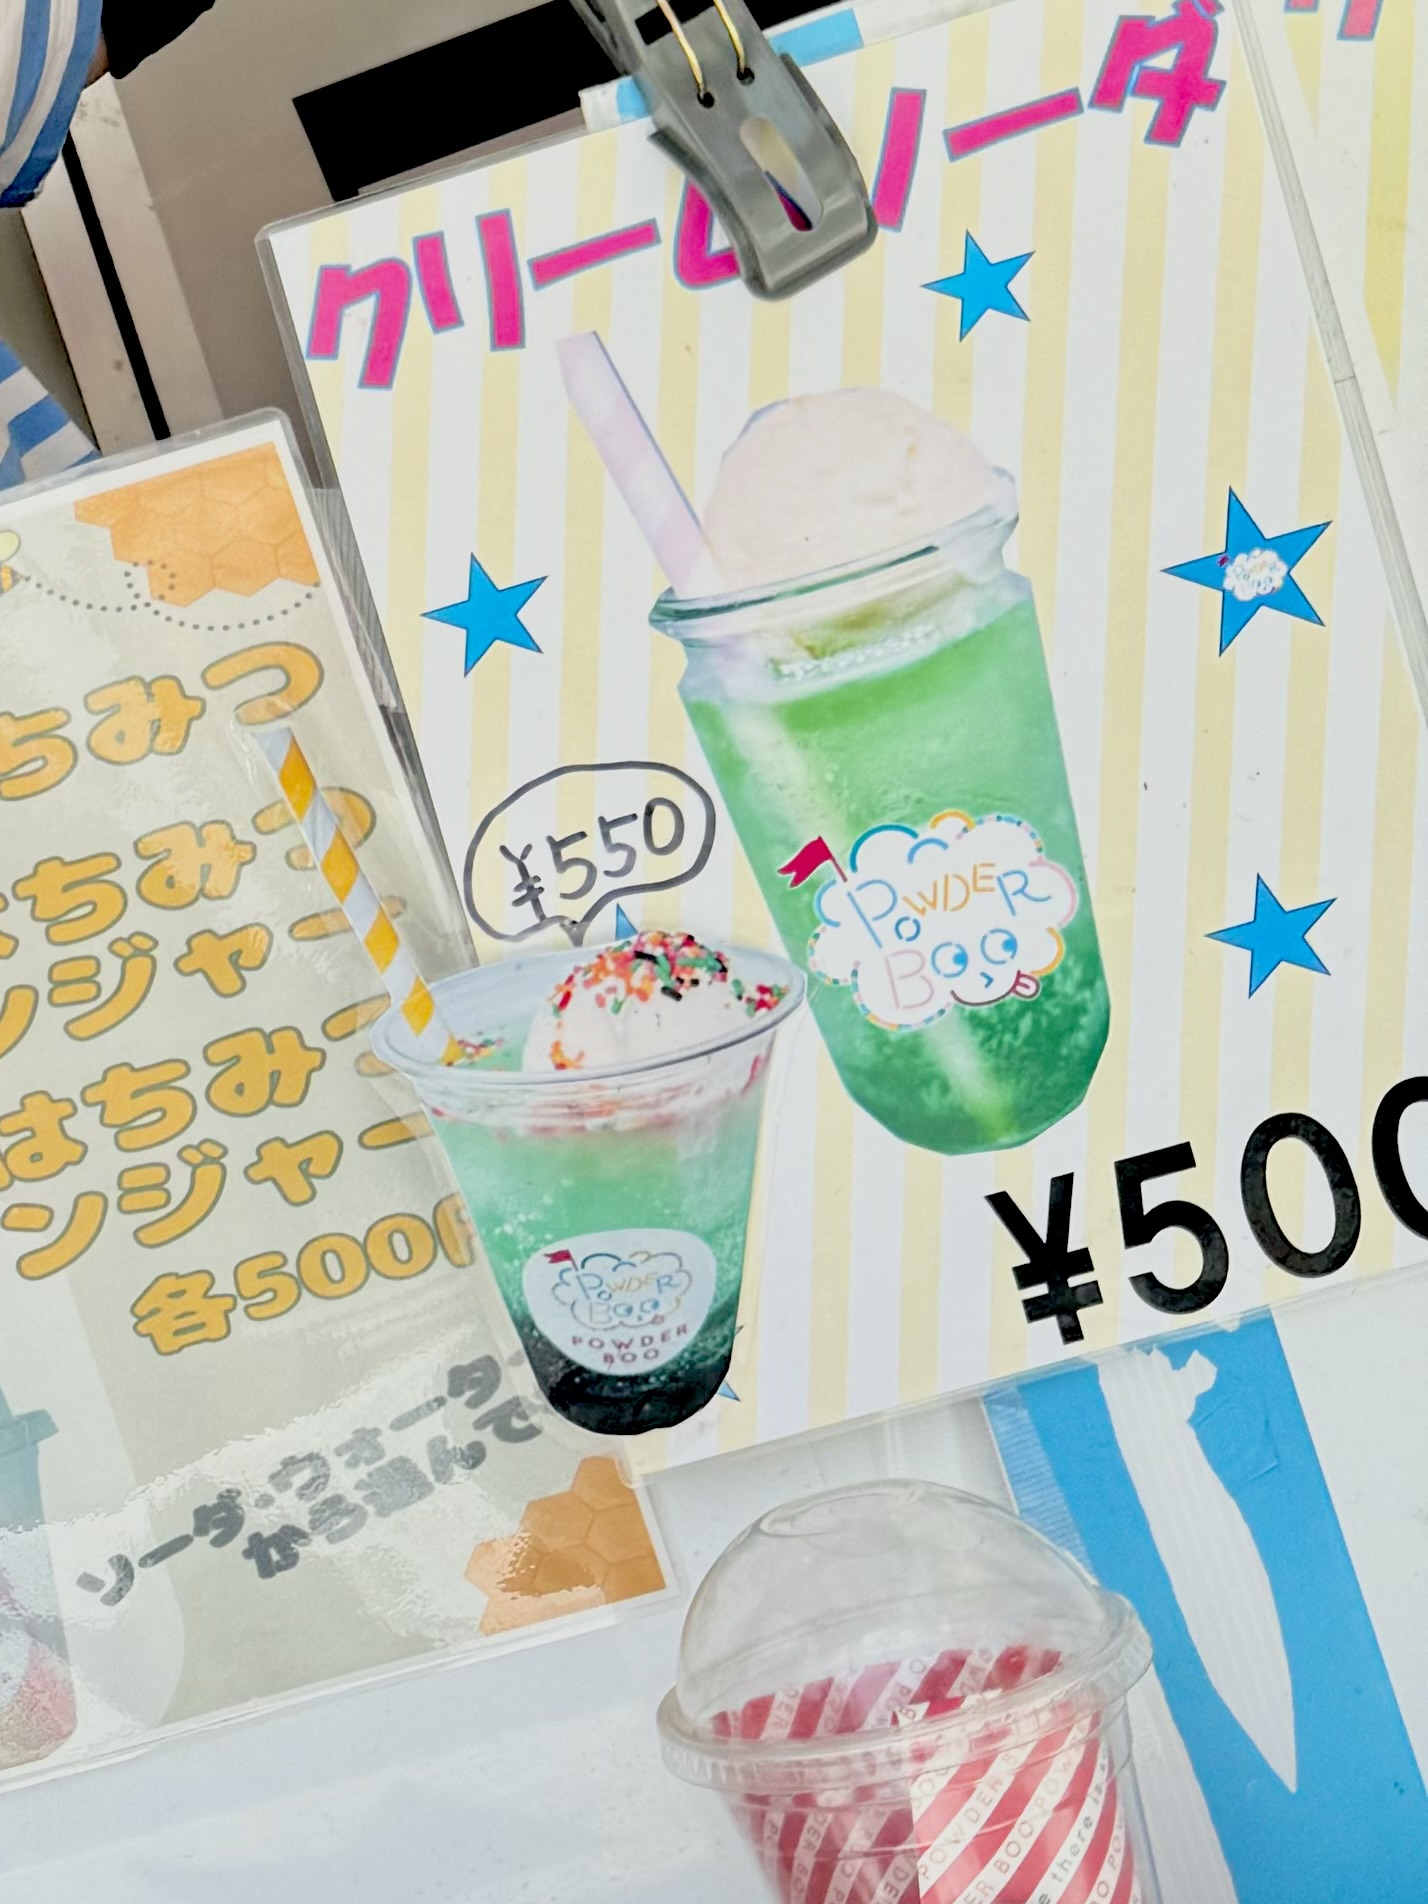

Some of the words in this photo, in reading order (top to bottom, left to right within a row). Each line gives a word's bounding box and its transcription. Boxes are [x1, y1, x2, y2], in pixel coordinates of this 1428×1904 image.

[499, 795, 689, 928] ¥550
[571, 1323, 688, 1351] POWDER
[602, 1348, 660, 1364] BOO
[993, 1818, 1036, 1876] BOO
[1050, 1813, 1095, 1884] there
